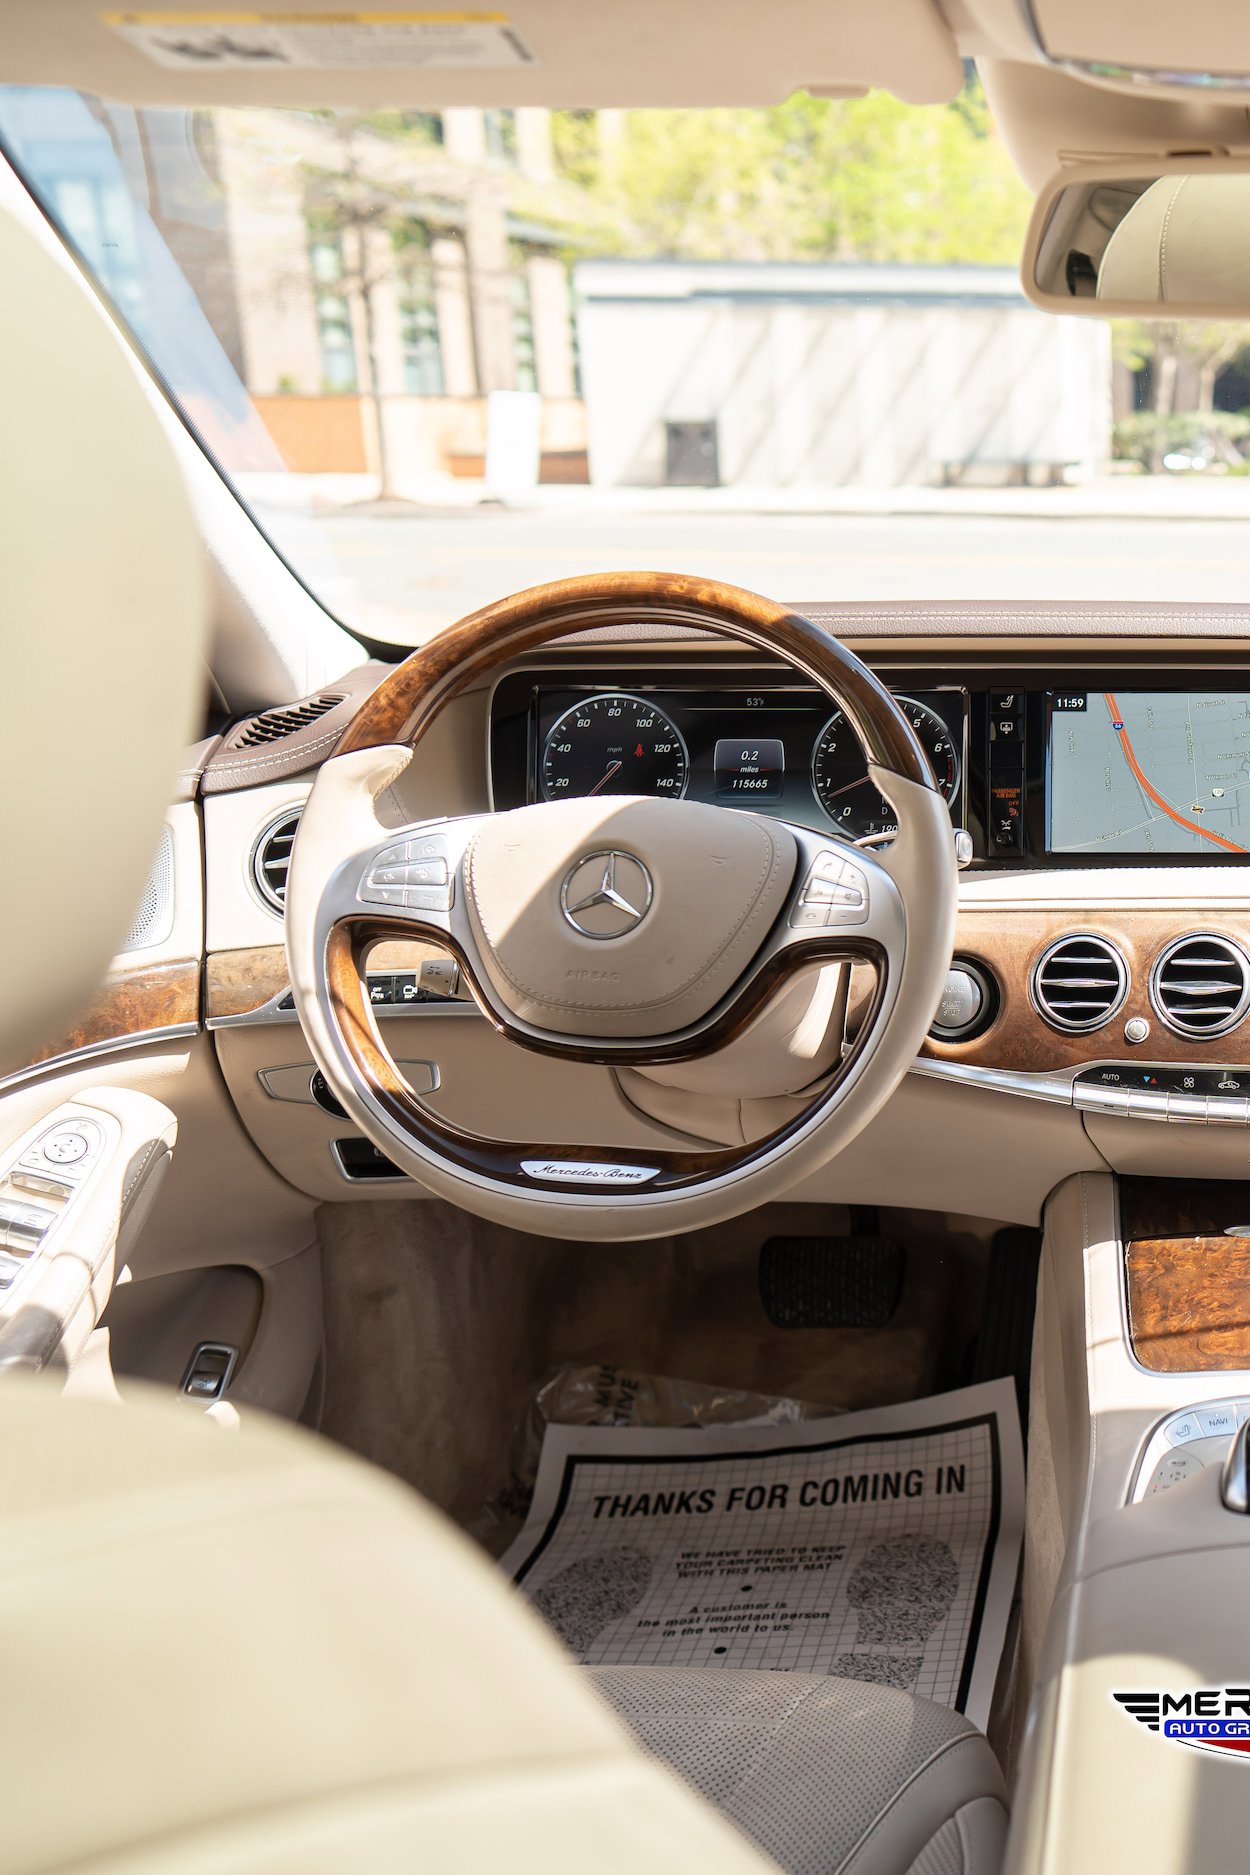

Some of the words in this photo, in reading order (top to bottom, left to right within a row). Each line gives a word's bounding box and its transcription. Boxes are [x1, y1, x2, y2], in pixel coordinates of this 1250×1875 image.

[1056, 698, 1084, 708] 11:59
[607, 708, 622, 717] 80
[576, 718, 591, 728] 60
[636, 719, 653, 728] 100
[912, 718, 922, 728] 5
[556, 744, 571, 753] 40
[606, 746, 623, 754] mph
[654, 744, 671, 753] 120
[827, 743, 836, 753] 2
[934, 743, 943, 752] 6
[741, 750, 759, 761] 0.2
[555, 778, 570, 787] 20
[656, 778, 674, 788] 140
[732, 779, 768, 789] 115665
[826, 778, 832, 787] 1
[938, 778, 946, 786] 7
[843, 807, 852, 816] 0
[881, 807, 888, 816] D
[566, 969, 621, 982] AIRBAG
[944, 986, 966, 994] NGINE
[1101, 1072, 1120, 1082] AUTO
[533, 1164, 643, 1179] Mercedes-Benz
[1208, 1418, 1228, 1428] NAVI
[592, 1489, 716, 1519] THANKS
[725, 1484, 789, 1512] FOR
[799, 1469, 924, 1508] COMING
[935, 1464, 966, 1495] IN
[680, 1551, 701, 1560] WE
[705, 1549, 743, 1559] HAVE
[746, 1548, 786, 1558] TRIED
[789, 1546, 808, 1556] TO
[810, 1545, 847, 1554] KEEP
[675, 1560, 713, 1570] YOUR
[717, 1556, 796, 1568] CARPETING
[798, 1554, 844, 1564] CLEAN
[677, 1569, 714, 1579] WITH
[717, 1567, 749, 1576] THIS
[753, 1564, 799, 1574] PAPER
[802, 1562, 833, 1572] MAT
[688, 1606, 698, 1614] A
[703, 1602, 770, 1614] customer
[774, 1601, 788, 1609] is
[637, 1620, 660, 1628] the
[665, 1616, 701, 1628] most
[704, 1612, 776, 1626] important
[780, 1611, 830, 1622] person
[662, 1628, 677, 1638] in
[681, 1626, 704, 1636] the
[708, 1624, 750, 1634] world
[754, 1623, 769, 1633] to
